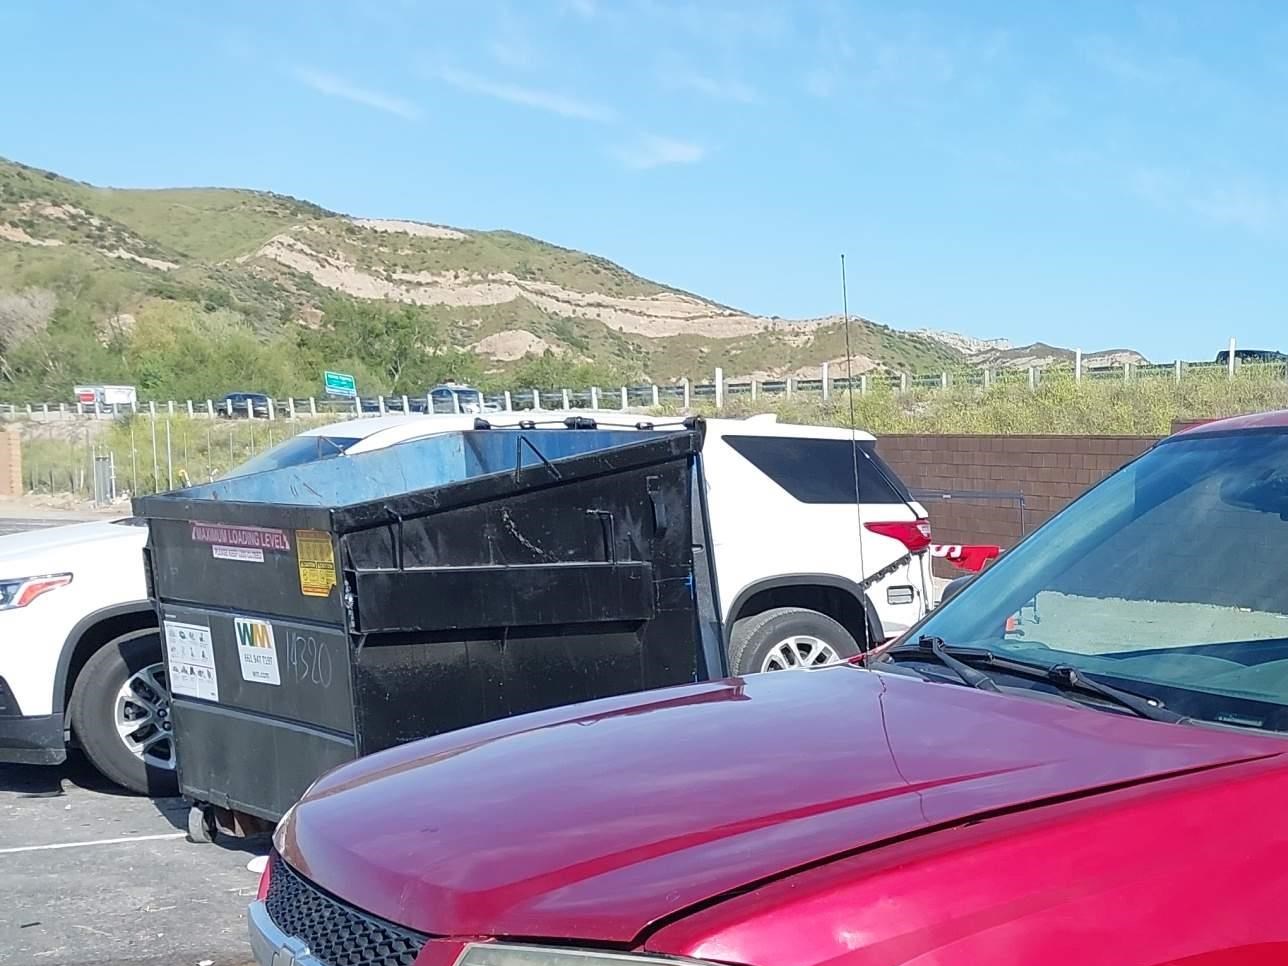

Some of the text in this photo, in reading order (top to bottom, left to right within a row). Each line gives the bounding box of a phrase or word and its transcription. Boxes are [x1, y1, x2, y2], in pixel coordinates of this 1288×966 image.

[195, 526, 285, 549] MAXIMUM LOADING LEVEL
[237, 621, 272, 648] WM
[286, 631, 332, 688] 14320
